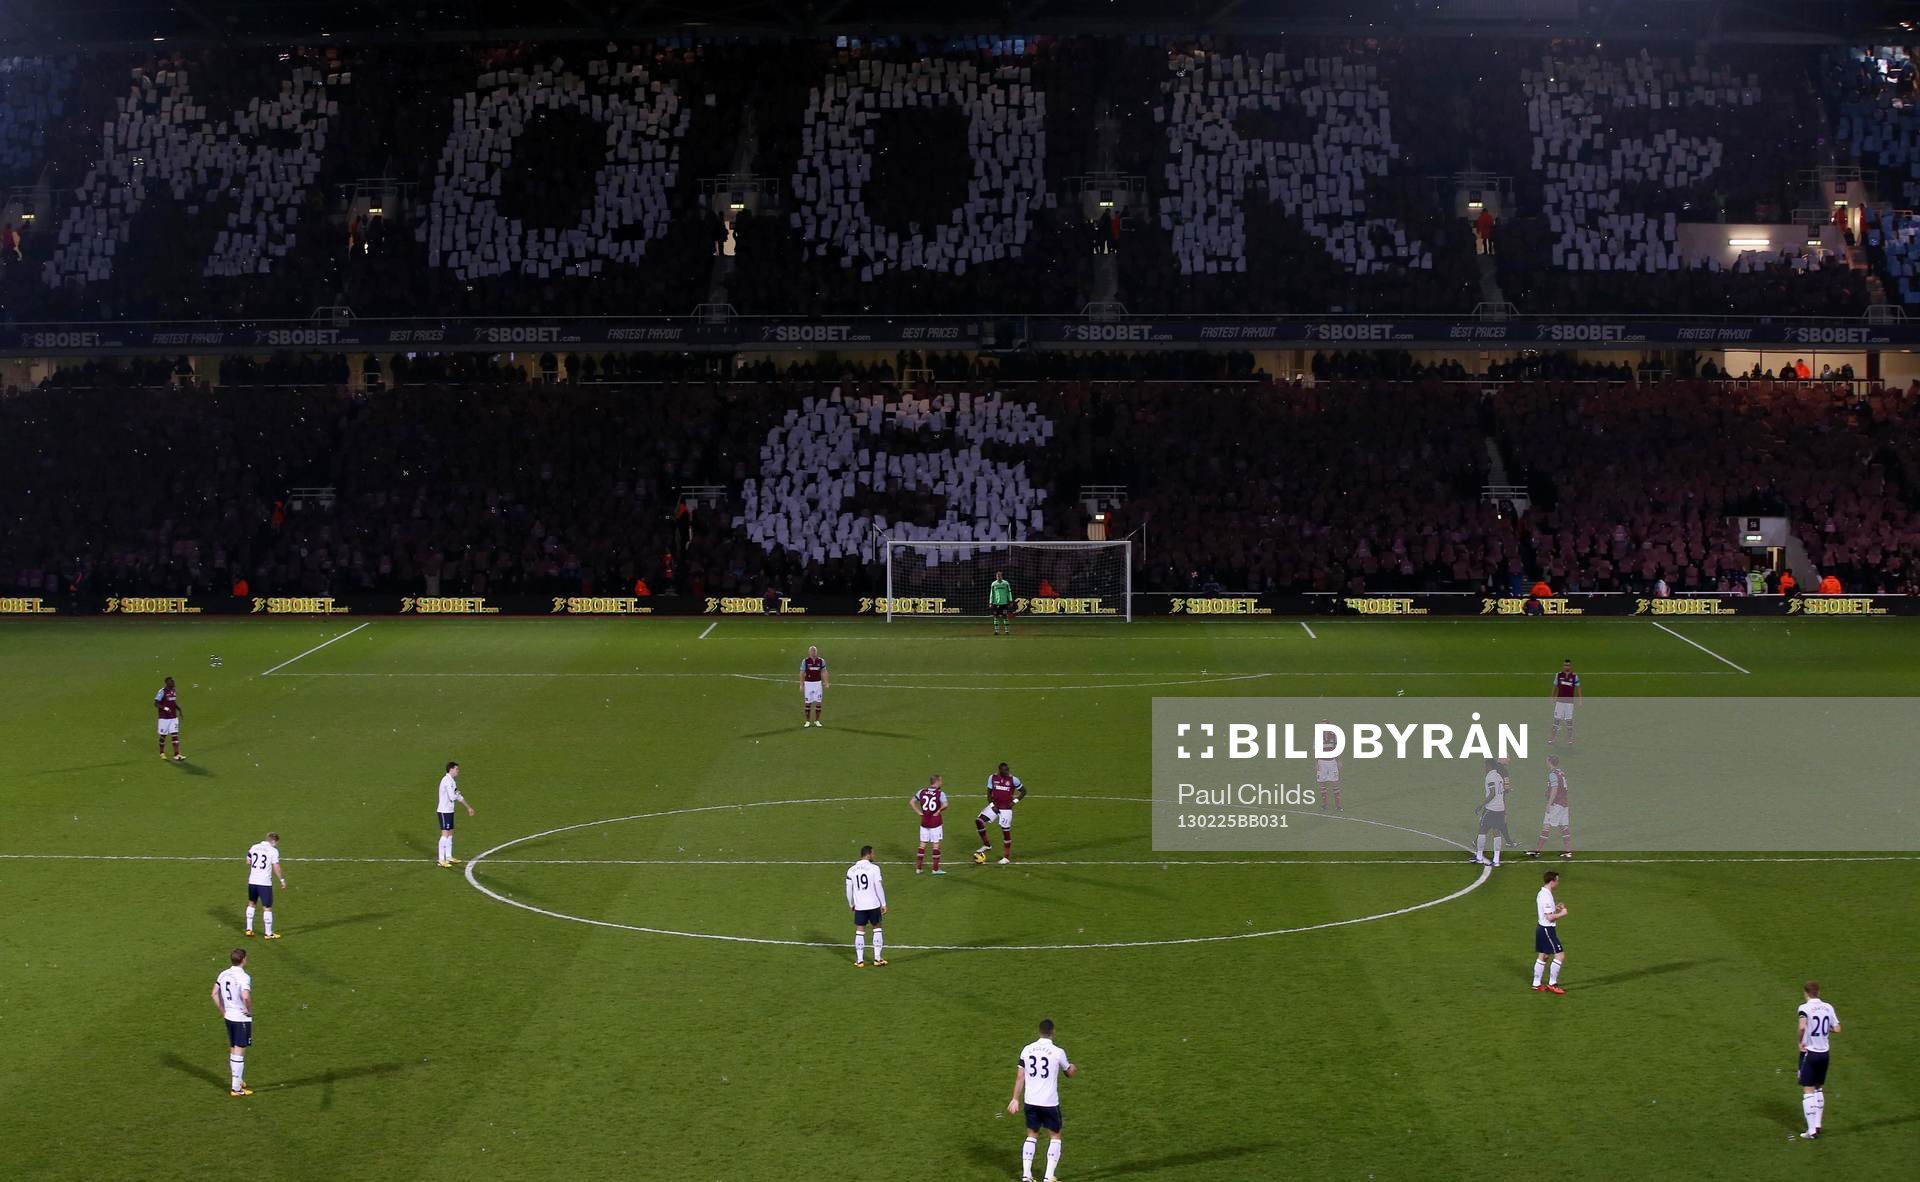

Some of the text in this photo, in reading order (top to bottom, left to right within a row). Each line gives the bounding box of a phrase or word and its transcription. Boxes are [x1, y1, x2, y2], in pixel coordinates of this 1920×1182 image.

[152, 333, 224, 344] FASTEST PAYOUT
[389, 331, 444, 342] BEST PRICES
[488, 327, 581, 343] SBOBET.com
[608, 329, 682, 339] FASTEST PAYOUT
[776, 326, 871, 342] SBOBET.com
[902, 327, 958, 338] BEST PRICES
[1077, 325, 1172, 340] SBOBET.com
[1200, 326, 1277, 337] FASTEST PAYOUT
[1319, 324, 1414, 340] SBOBET.com
[1450, 326, 1507, 337] BEST PRICES
[1551, 324, 1646, 341] SBOBET.com
[1678, 328, 1752, 339] FASTEST PAYOUT
[1797, 328, 1890, 343] SBOBET.com
[922, 795, 937, 811] 26
[251, 852, 267, 870] 23
[856, 873, 869, 890] 19
[225, 981, 232, 1000] 5
[1810, 1015, 1830, 1037] 20
[1028, 1055, 1050, 1079] 33
